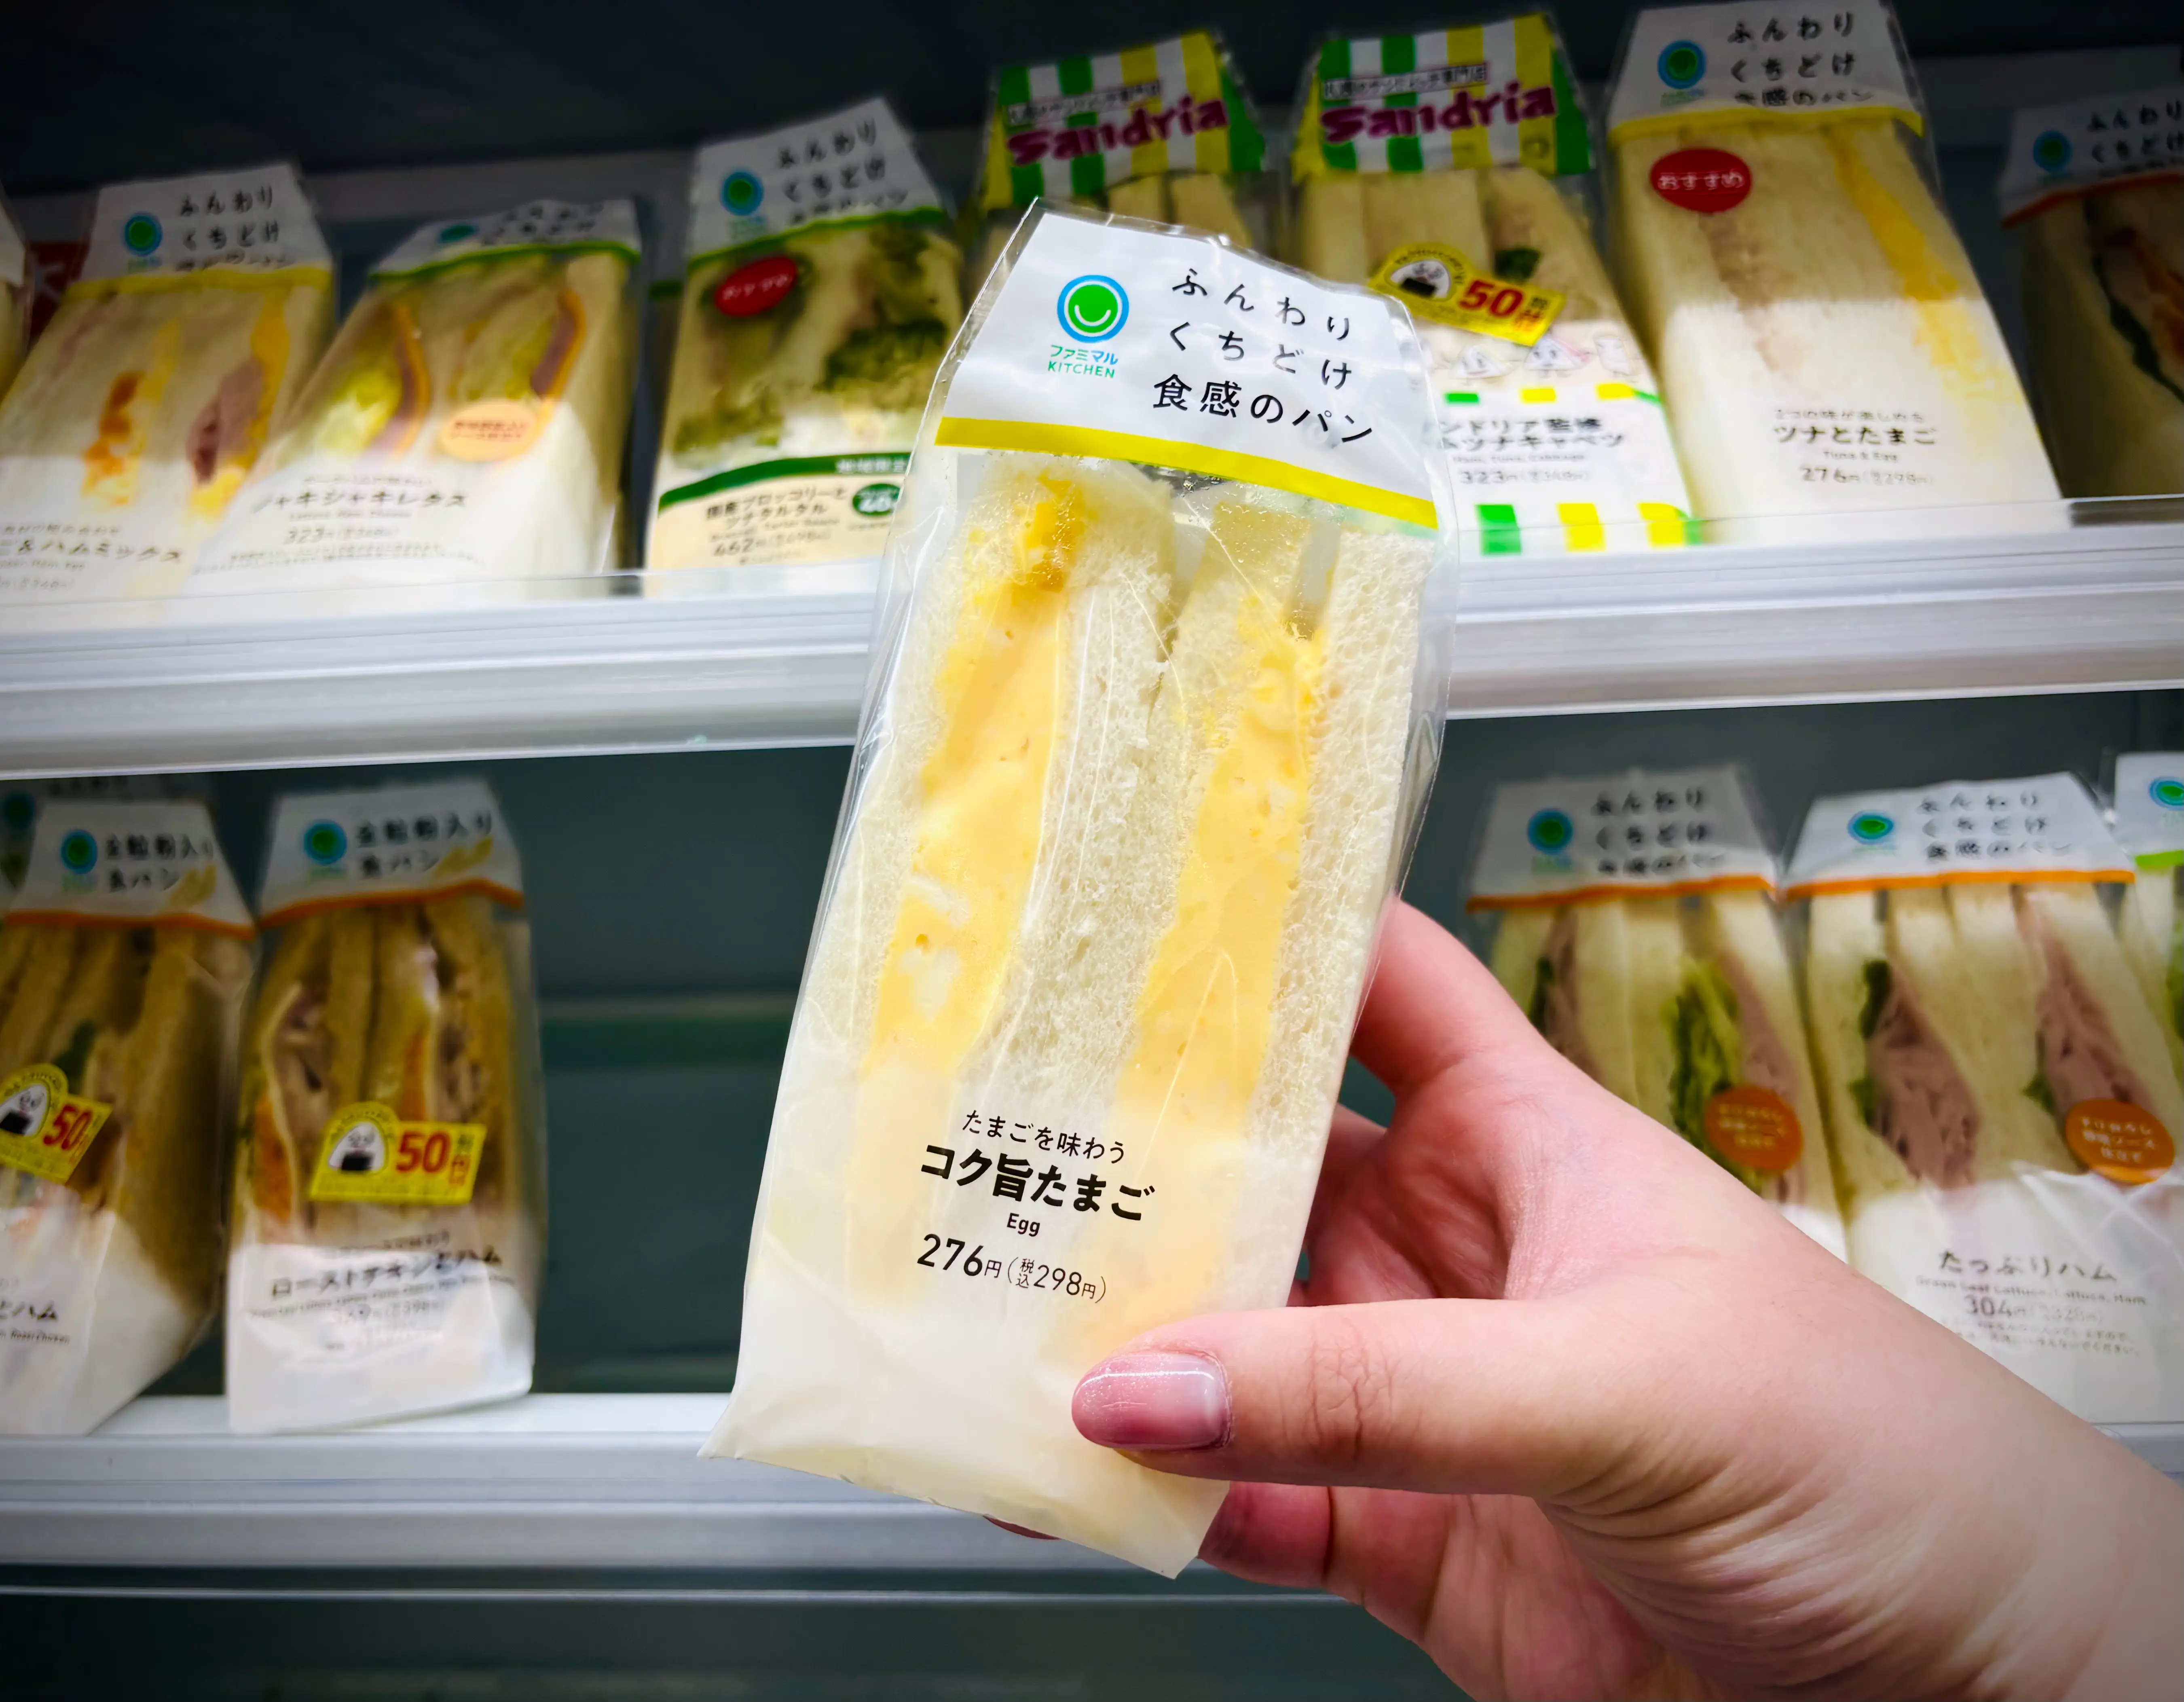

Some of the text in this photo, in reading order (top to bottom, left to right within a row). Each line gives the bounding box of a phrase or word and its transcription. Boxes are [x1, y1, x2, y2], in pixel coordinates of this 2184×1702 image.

[1727, 11, 1855, 44] ふんわり
[1731, 50, 1855, 81] くちどけ
[1007, 93, 1228, 166] Sandria
[1321, 80, 1556, 144] Sandria
[1658, 170, 1745, 190] おすすめ
[1172, 268, 1350, 341] ふんわり
[1459, 279, 1524, 318] 50
[1048, 360, 1115, 379] KITCHEN
[1050, 344, 1119, 367] ファミマル
[1169, 321, 1352, 390] くちどけ
[1152, 374, 1373, 444] 食感のパン
[1774, 426, 1937, 444] ツナとたまご
[396, 1131, 451, 1173] 50
[962, 1110, 1124, 1164] たまごを味わう
[921, 1144, 1155, 1221] コク旨たまご
[1006, 1212, 1040, 1237] Egg
[1938, 1250, 2117, 1283] たっぷりハム
